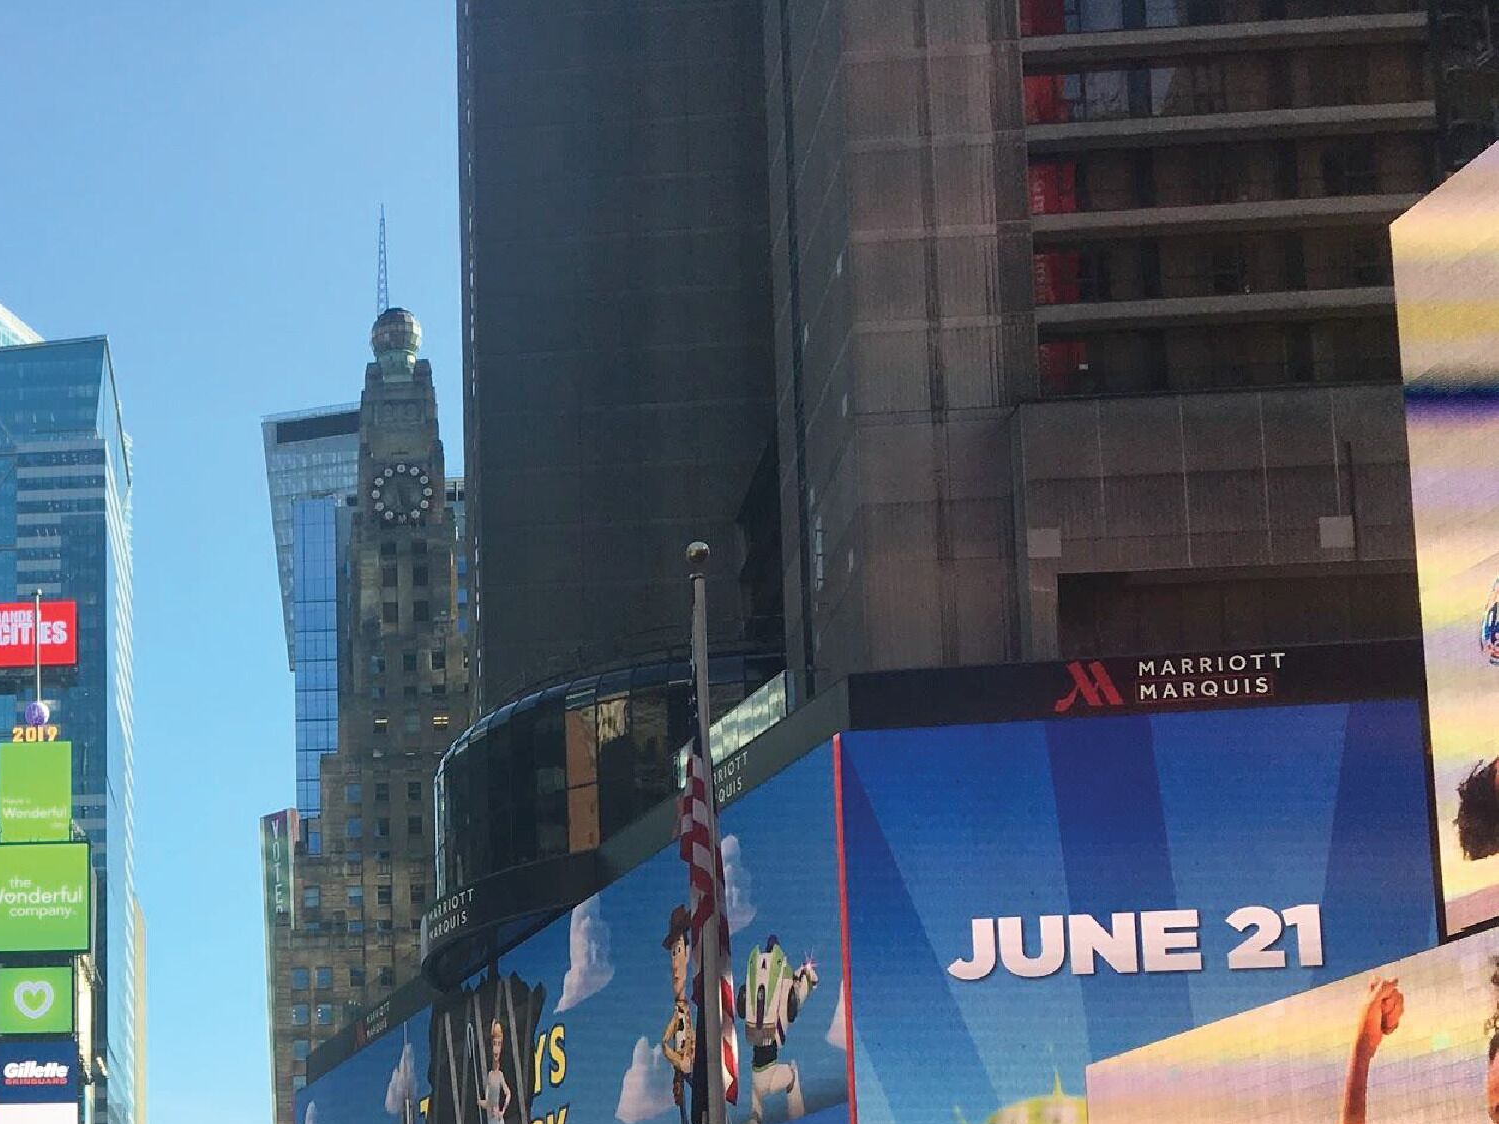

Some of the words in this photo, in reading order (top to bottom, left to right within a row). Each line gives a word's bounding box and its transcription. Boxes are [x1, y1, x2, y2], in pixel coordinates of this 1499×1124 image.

[1138, 652, 1286, 677] MARRIOTT
[1139, 676, 1270, 701] MARQUIS
[12, 727, 58, 742] 2019
[9, 875, 32, 888] the
[9, 906, 72, 920] company
[428, 888, 475, 921] MARRIOTT
[429, 910, 469, 940] MARQUIS
[947, 910, 1204, 981] JUNE
[1227, 904, 1325, 969] 21
[3, 1060, 70, 1079] Gillette
